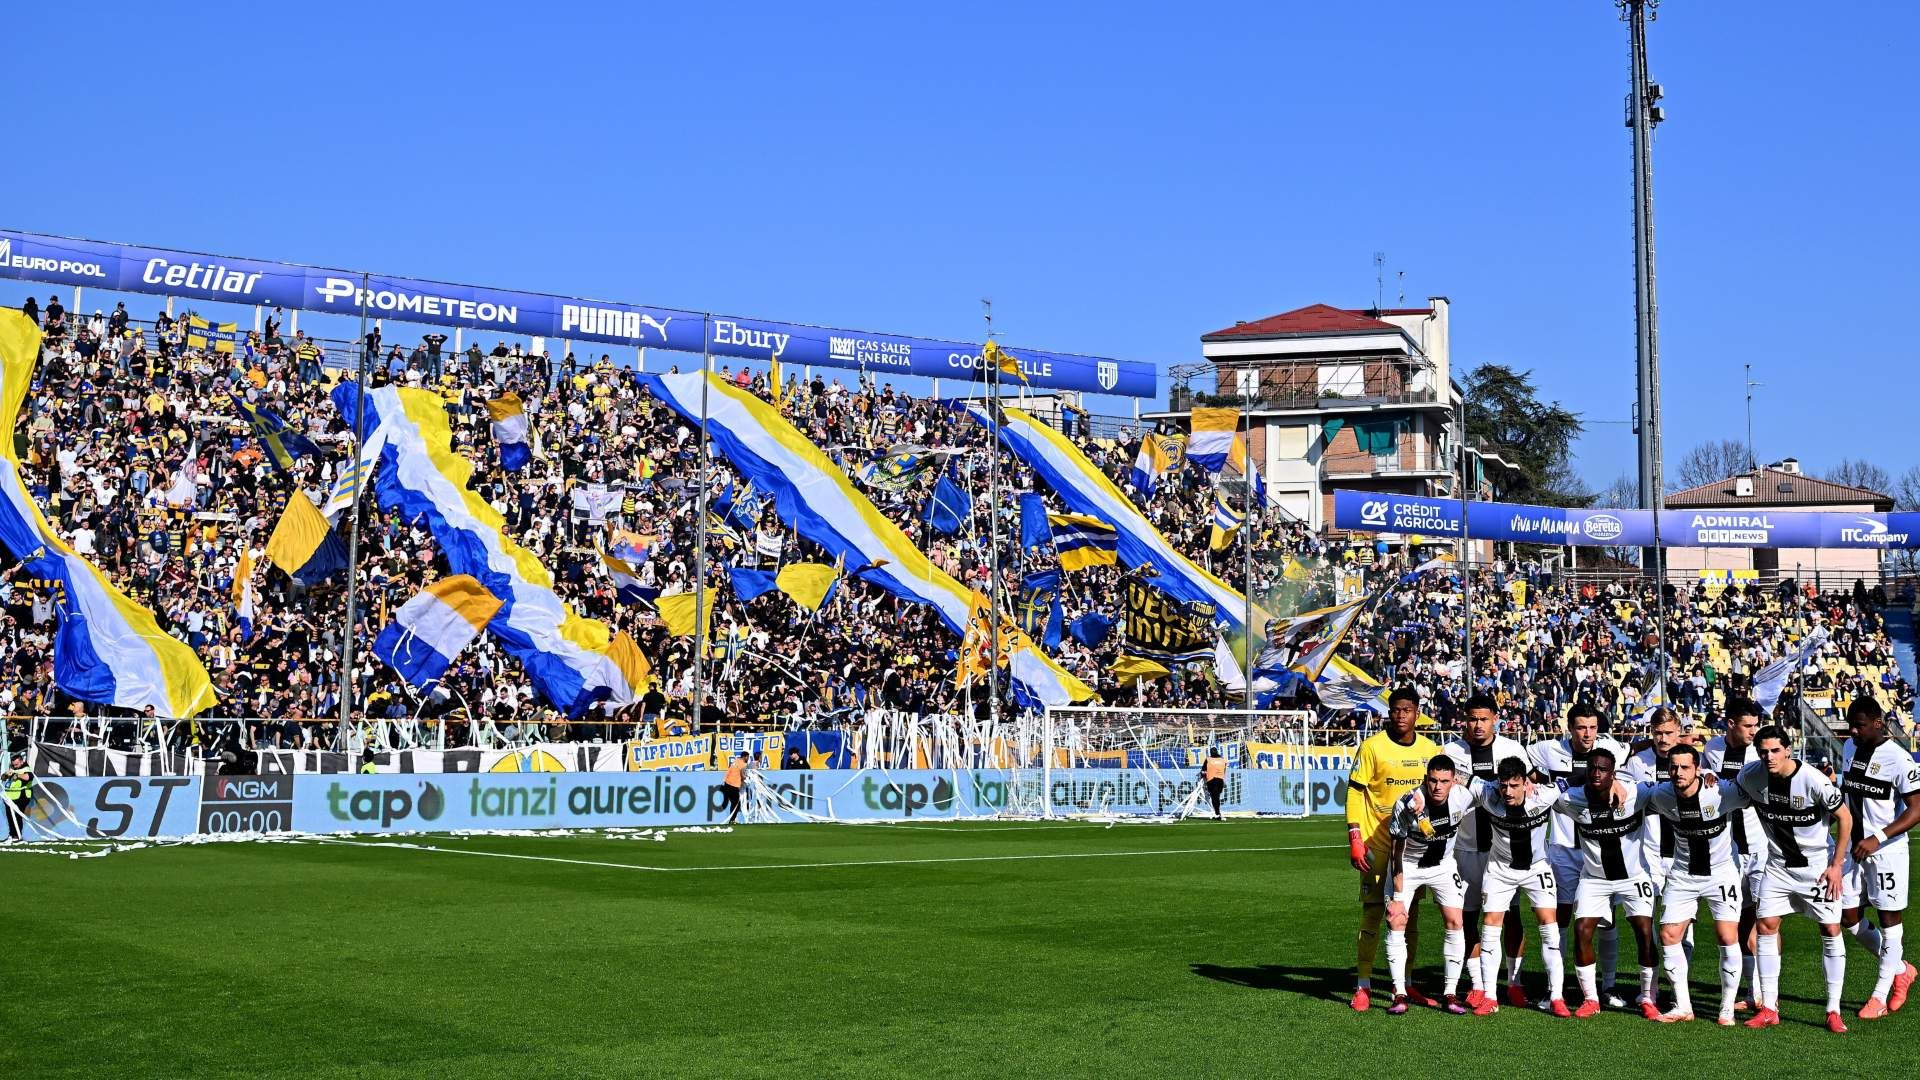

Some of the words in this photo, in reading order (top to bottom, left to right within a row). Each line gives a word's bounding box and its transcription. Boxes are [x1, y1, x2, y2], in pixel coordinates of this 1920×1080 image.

[12, 255, 58, 271] EURO
[60, 260, 106, 278] POOL
[142, 258, 263, 295] Cetilar
[315, 278, 517, 324] PROMETEON
[562, 304, 640, 339] PUMA
[192, 328, 233, 340] METEOPARMA
[713, 320, 790, 356] Ebury
[856, 339, 879, 352] GAS
[880, 341, 911, 355] SALES
[857, 351, 911, 367] ENERGIA
[948, 353, 1052, 377] COCELLE
[1393, 502, 1441, 518] CRÉDIT
[1393, 516, 1459, 532] AGRICOLE
[1540, 516, 1580, 535] MAMMA
[1585, 521, 1621, 533] Beretta
[1691, 515, 1775, 529] ADMIRAL
[223, 780, 278, 799] NGM
[469, 777, 556, 817] tanzi
[568, 776, 697, 816] aurelio
[861, 776, 929, 816] tap
[327, 782, 412, 827] tap
[208, 810, 282, 833] 00:00
[1452, 872, 1463, 890] 8
[1537, 872, 1554, 890] 15
[1634, 881, 1653, 898] 16
[1877, 872, 1896, 891] 13
[1718, 884, 1738, 902] 14
